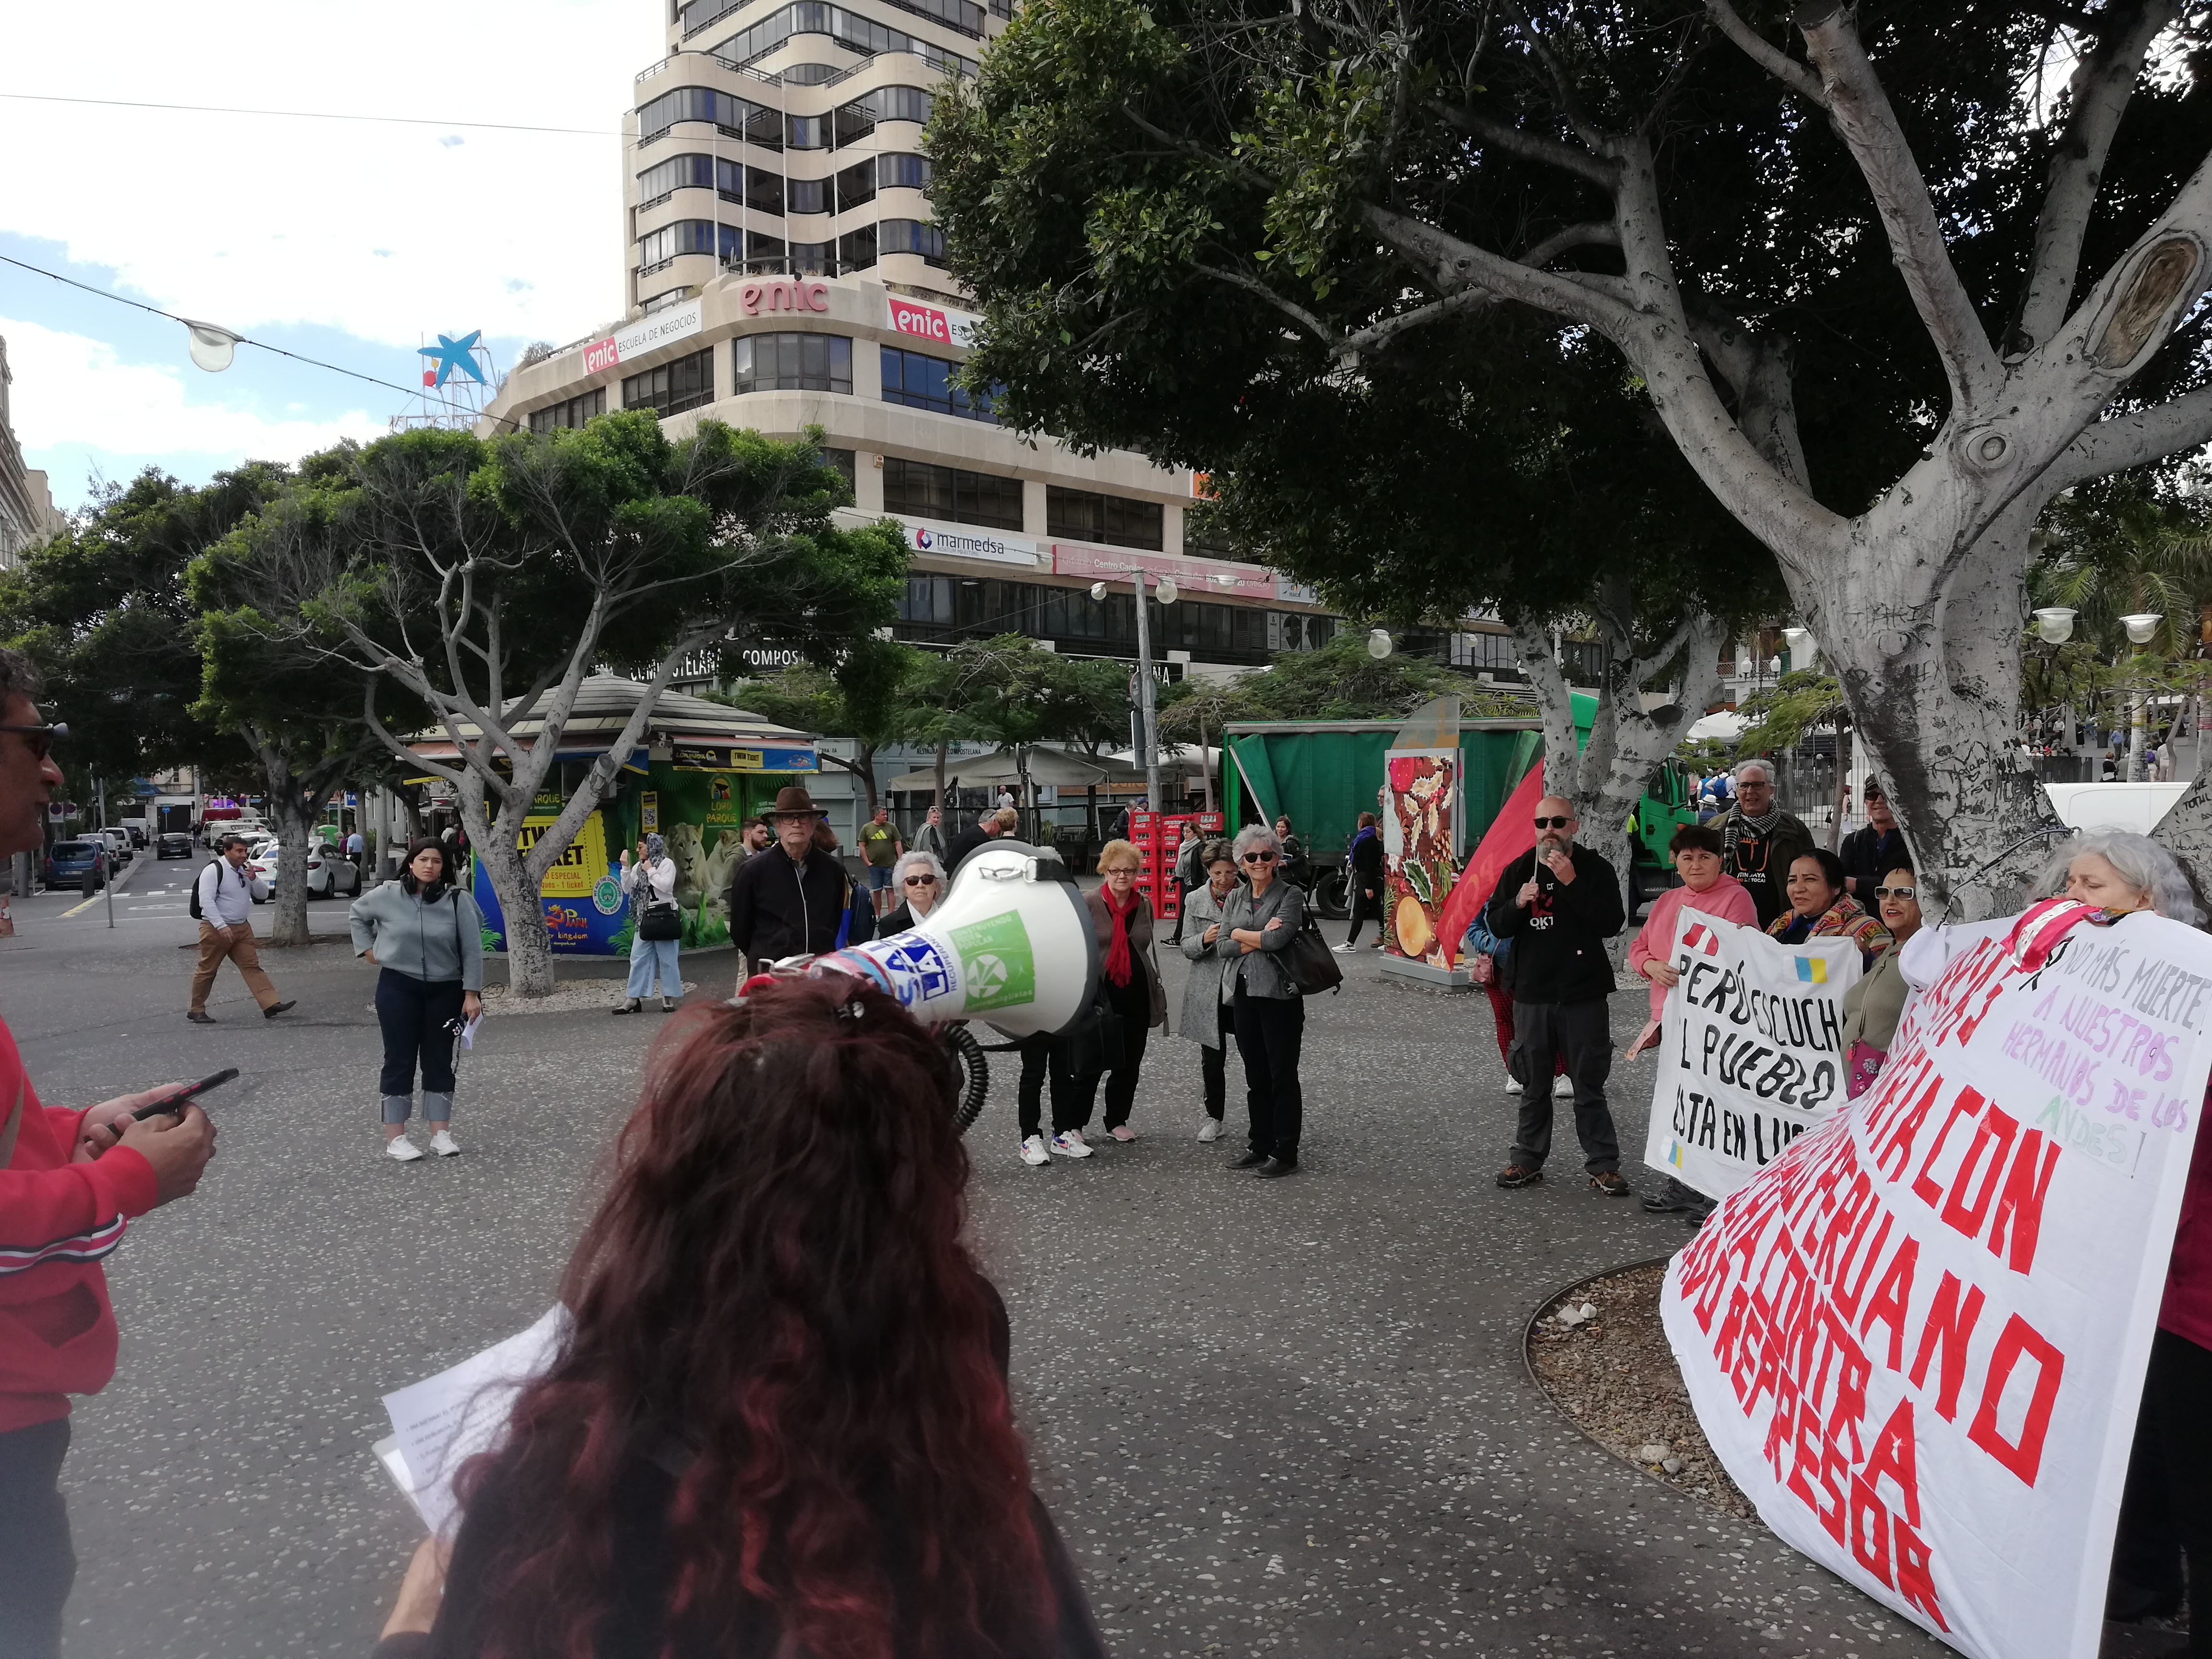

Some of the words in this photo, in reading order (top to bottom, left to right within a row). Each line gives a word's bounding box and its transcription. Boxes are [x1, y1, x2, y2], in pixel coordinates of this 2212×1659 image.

[740, 271, 828, 315] enic
[619, 333, 646, 353] ESCUELA
[649, 327, 658, 340] DE
[661, 312, 696, 336] NEGOCIOS
[898, 309, 944, 338] enic
[588, 341, 615, 372] enic
[938, 533, 1004, 554] marmedsa
[1094, 559, 1118, 570] Centro
[534, 793, 560, 805] ARQUE
[706, 813, 738, 824] PARQUE
[711, 801, 732, 811] LORO
[551, 872, 581, 880] ESPECIAL
[566, 880, 584, 889] ticket
[607, 877, 622, 898] CHAMPIONS
[558, 931, 589, 941] kingdom
[2055, 941, 2095, 975] NO
[2081, 939, 2130, 993] MÁS
[1679, 953, 1751, 1025] PERÚ
[1750, 988, 1841, 1052] ESCUCH
[2032, 985, 2061, 1021] A
[2061, 993, 2179, 1082] NUESTROS
[1703, 1024, 1836, 1109] PUEBLO
[2001, 1020, 2102, 1106] HERMANOS
[2104, 1078, 2148, 1121] DE
[2151, 1092, 2188, 1133] LOS
[1724, 1109, 1746, 1161] EN
[1911, 1084, 2063, 1277] CON
[1789, 1134, 2065, 1490] PERUANO
[1750, 1220, 1921, 1530] CONTRA
[1714, 1280, 1950, 1633] REPRESOR
